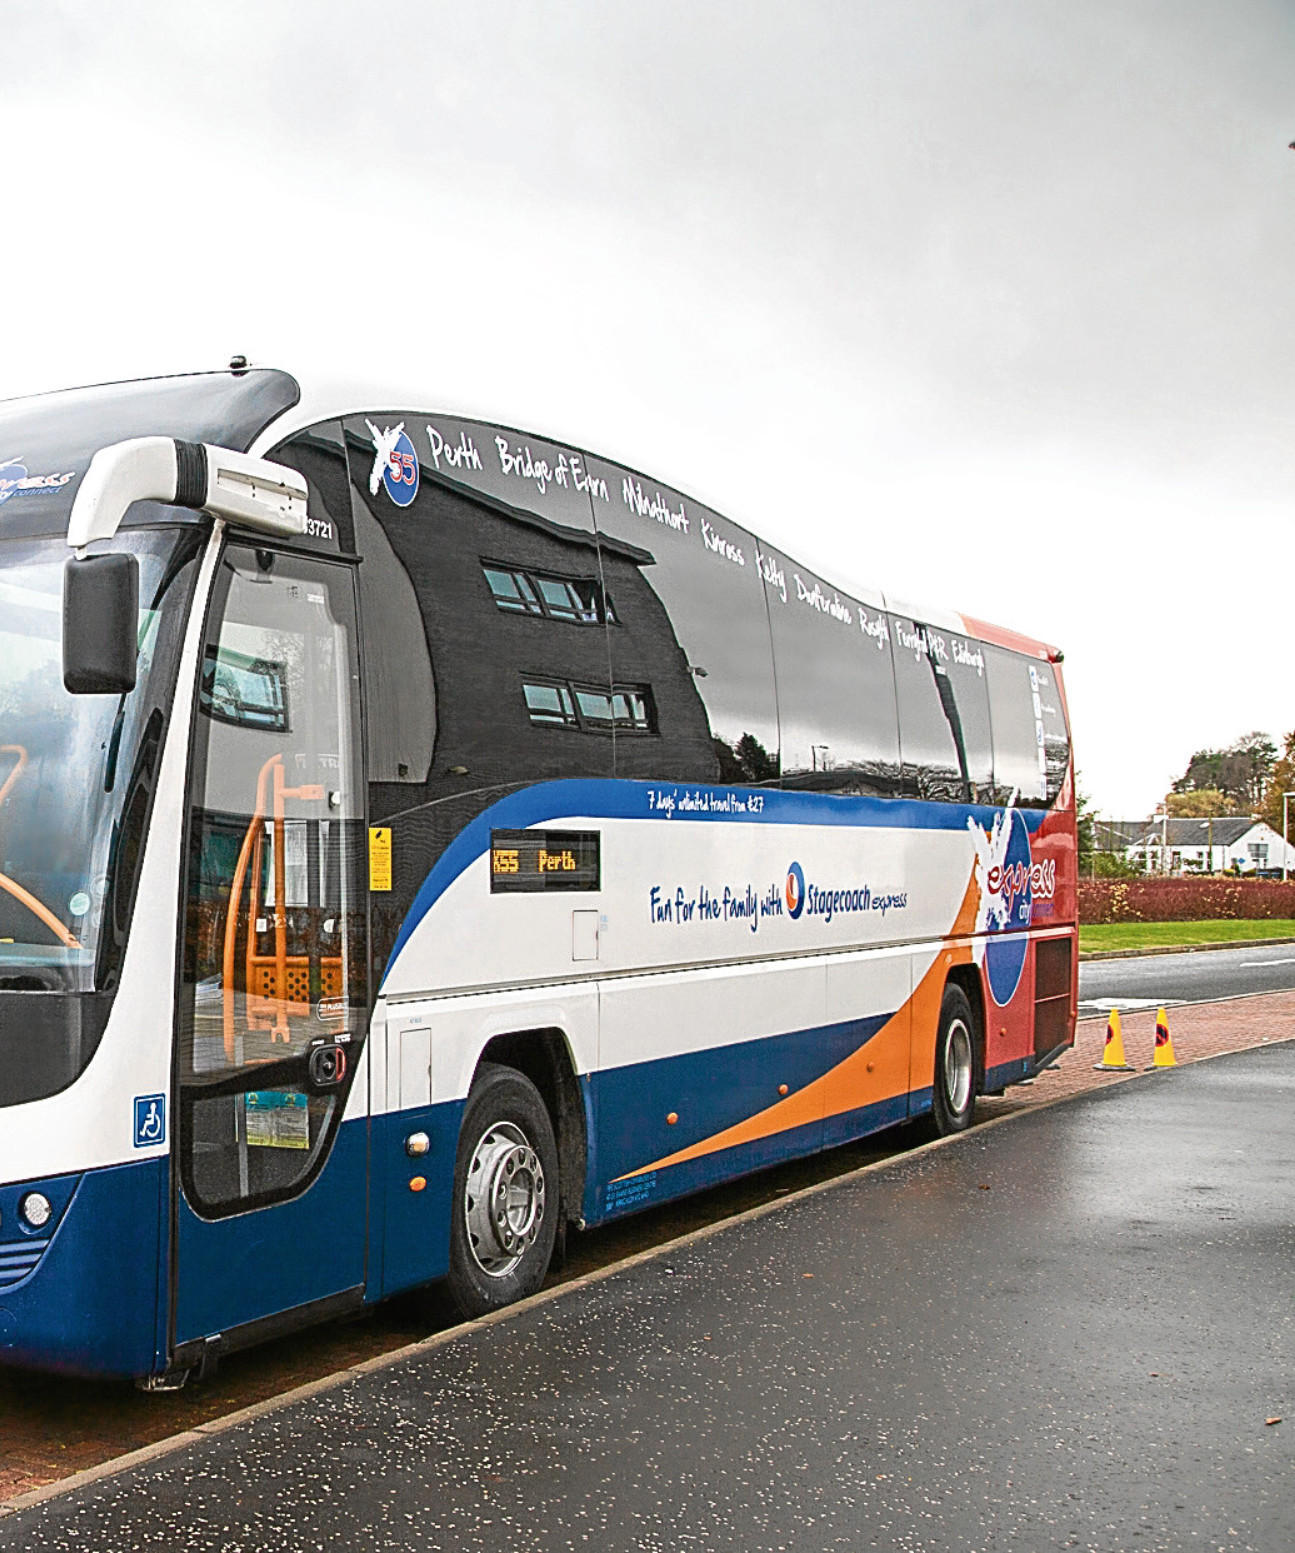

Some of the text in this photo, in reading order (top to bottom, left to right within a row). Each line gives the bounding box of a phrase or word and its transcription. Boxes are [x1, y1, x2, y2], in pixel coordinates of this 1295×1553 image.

[13, 486, 62, 498] connect
[426, 424, 483, 471] Perth
[494, 435, 553, 495] Bridge
[555, 453, 569, 488] of
[701, 518, 745, 566] Kinross
[647, 790, 655, 810] 7
[538, 849, 576, 874] Perth
[806, 884, 908, 923] Stagecoach express
[987, 858, 1055, 916] express
[649, 885, 672, 924] Fun
[674, 886, 695, 924] for
[697, 884, 721, 921] the
[722, 884, 759, 933] family
[760, 883, 784, 918] with
